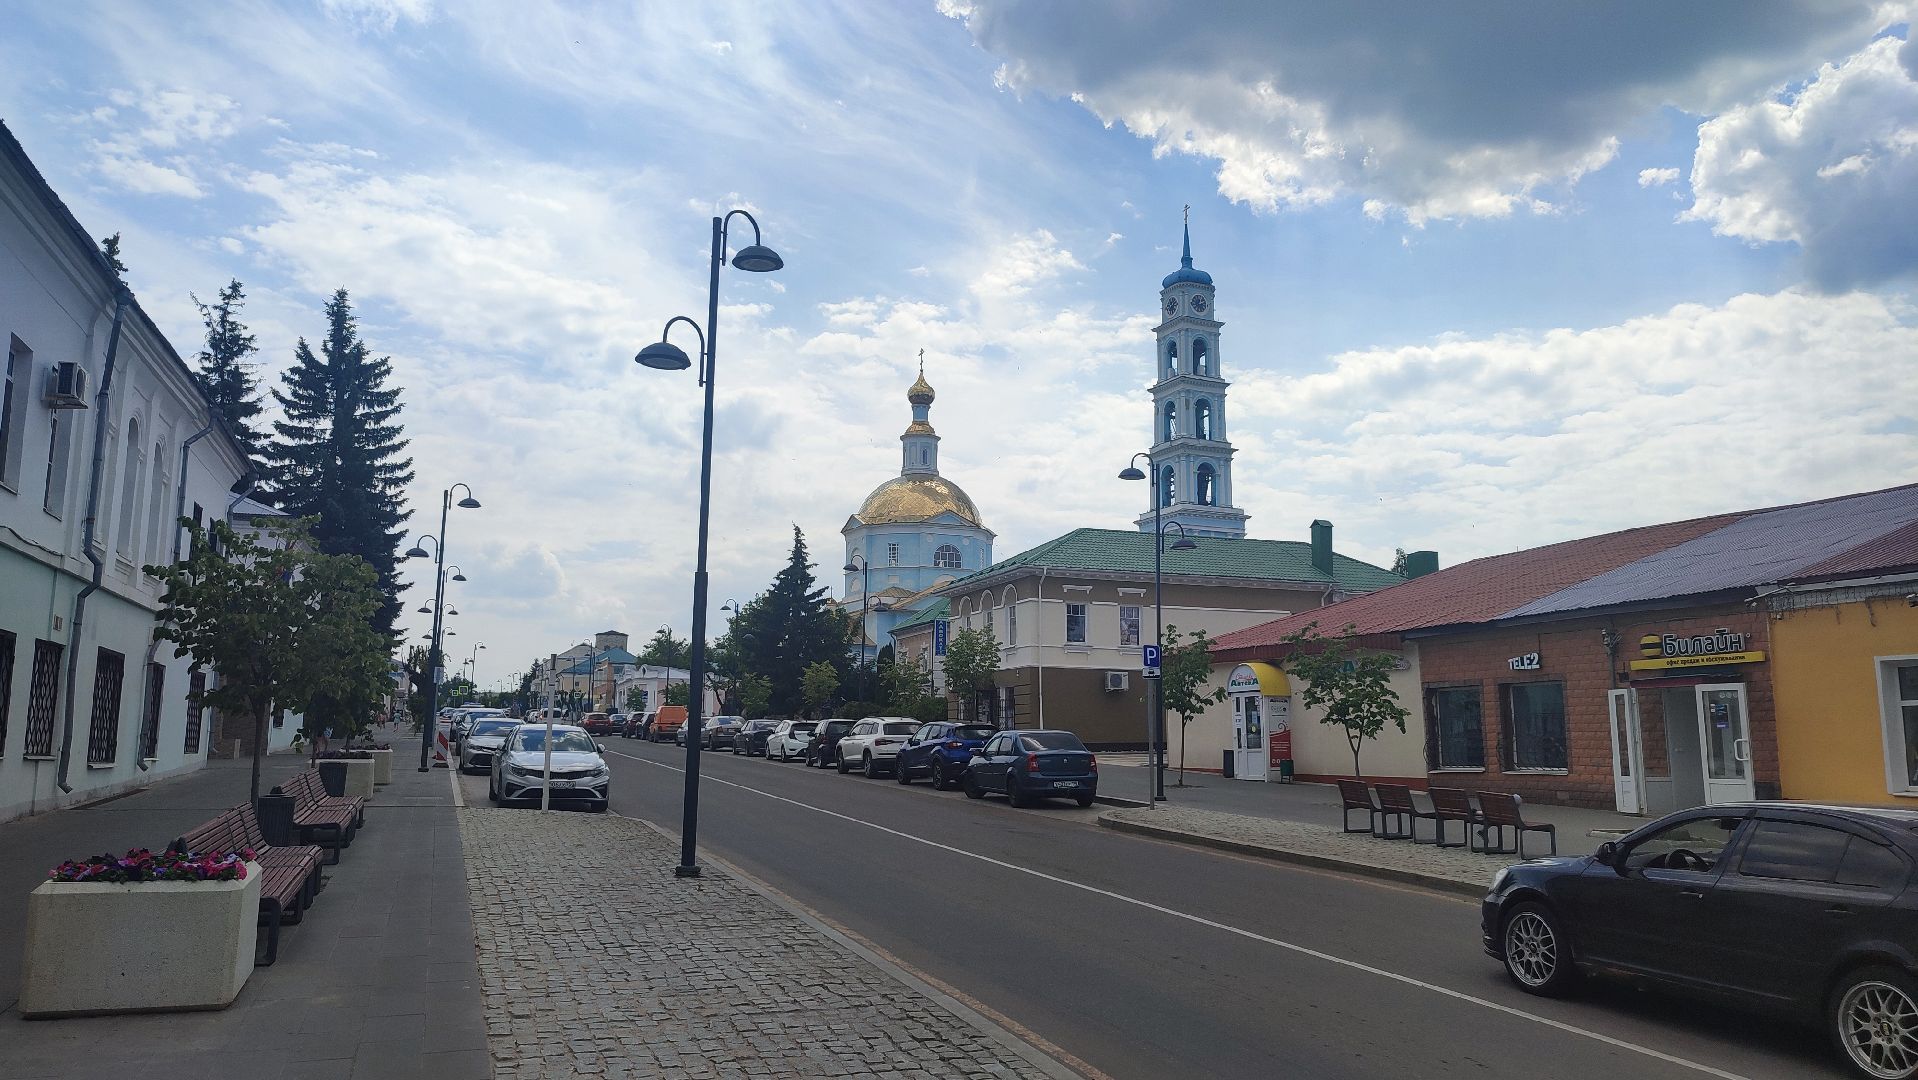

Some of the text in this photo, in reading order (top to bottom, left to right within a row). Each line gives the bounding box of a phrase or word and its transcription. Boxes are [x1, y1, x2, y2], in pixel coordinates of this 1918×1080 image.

[1662, 628, 1744, 657] Билайн
[1146, 647, 1157, 665] P
[1508, 652, 1540, 671] TELE2
